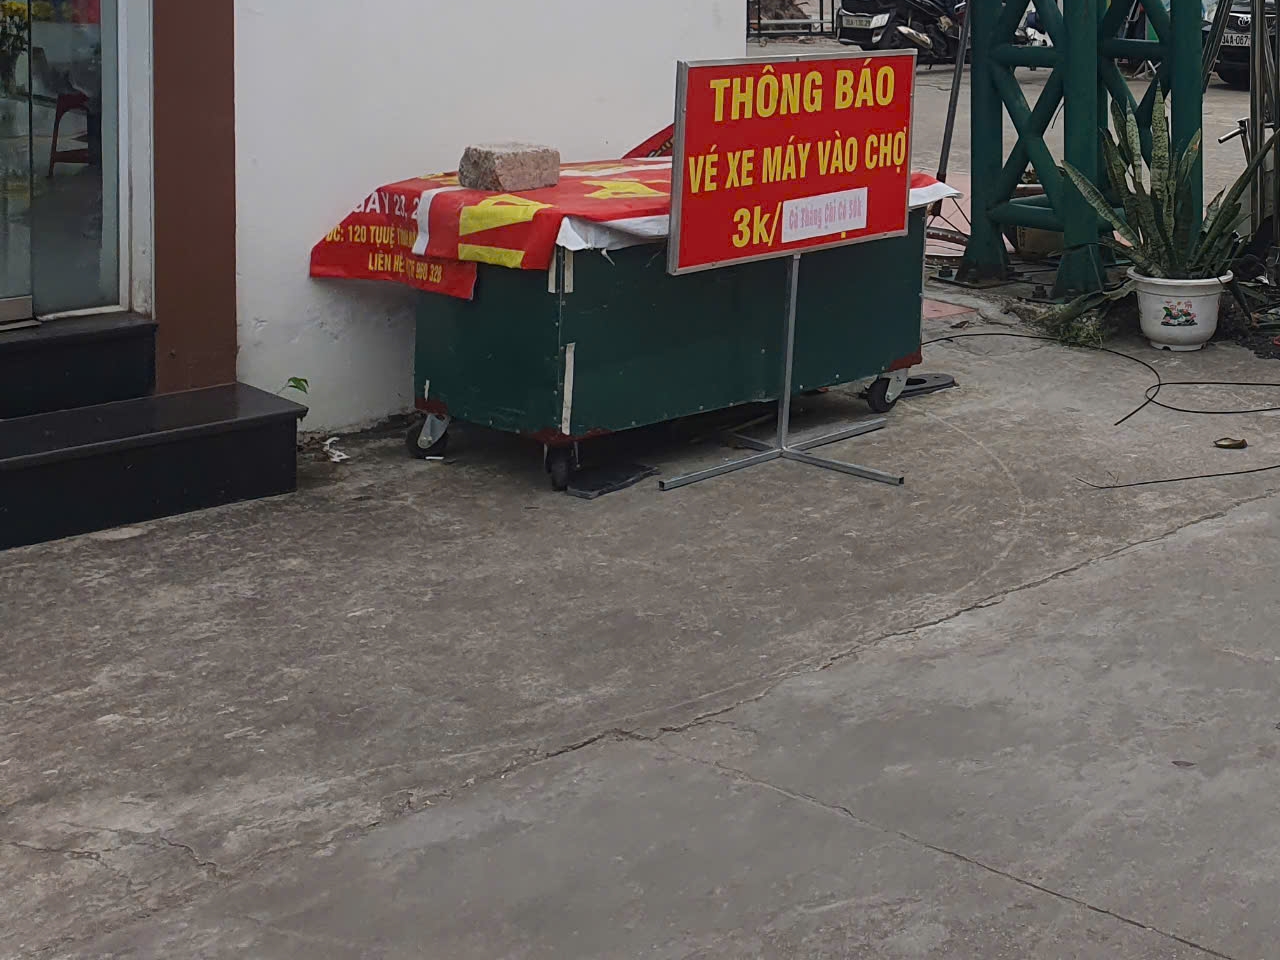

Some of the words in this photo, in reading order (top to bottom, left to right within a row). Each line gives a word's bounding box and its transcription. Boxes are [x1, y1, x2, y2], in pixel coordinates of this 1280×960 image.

[710, 65, 822, 122] THÔNG
[835, 58, 895, 110] BÁO
[689, 144, 717, 193] VÉ
[725, 149, 754, 188] XE
[762, 136, 811, 184] MÁY
[818, 131, 857, 175] VÀO
[865, 126, 908, 173] CHỢ
[348, 225, 367, 242] 120
